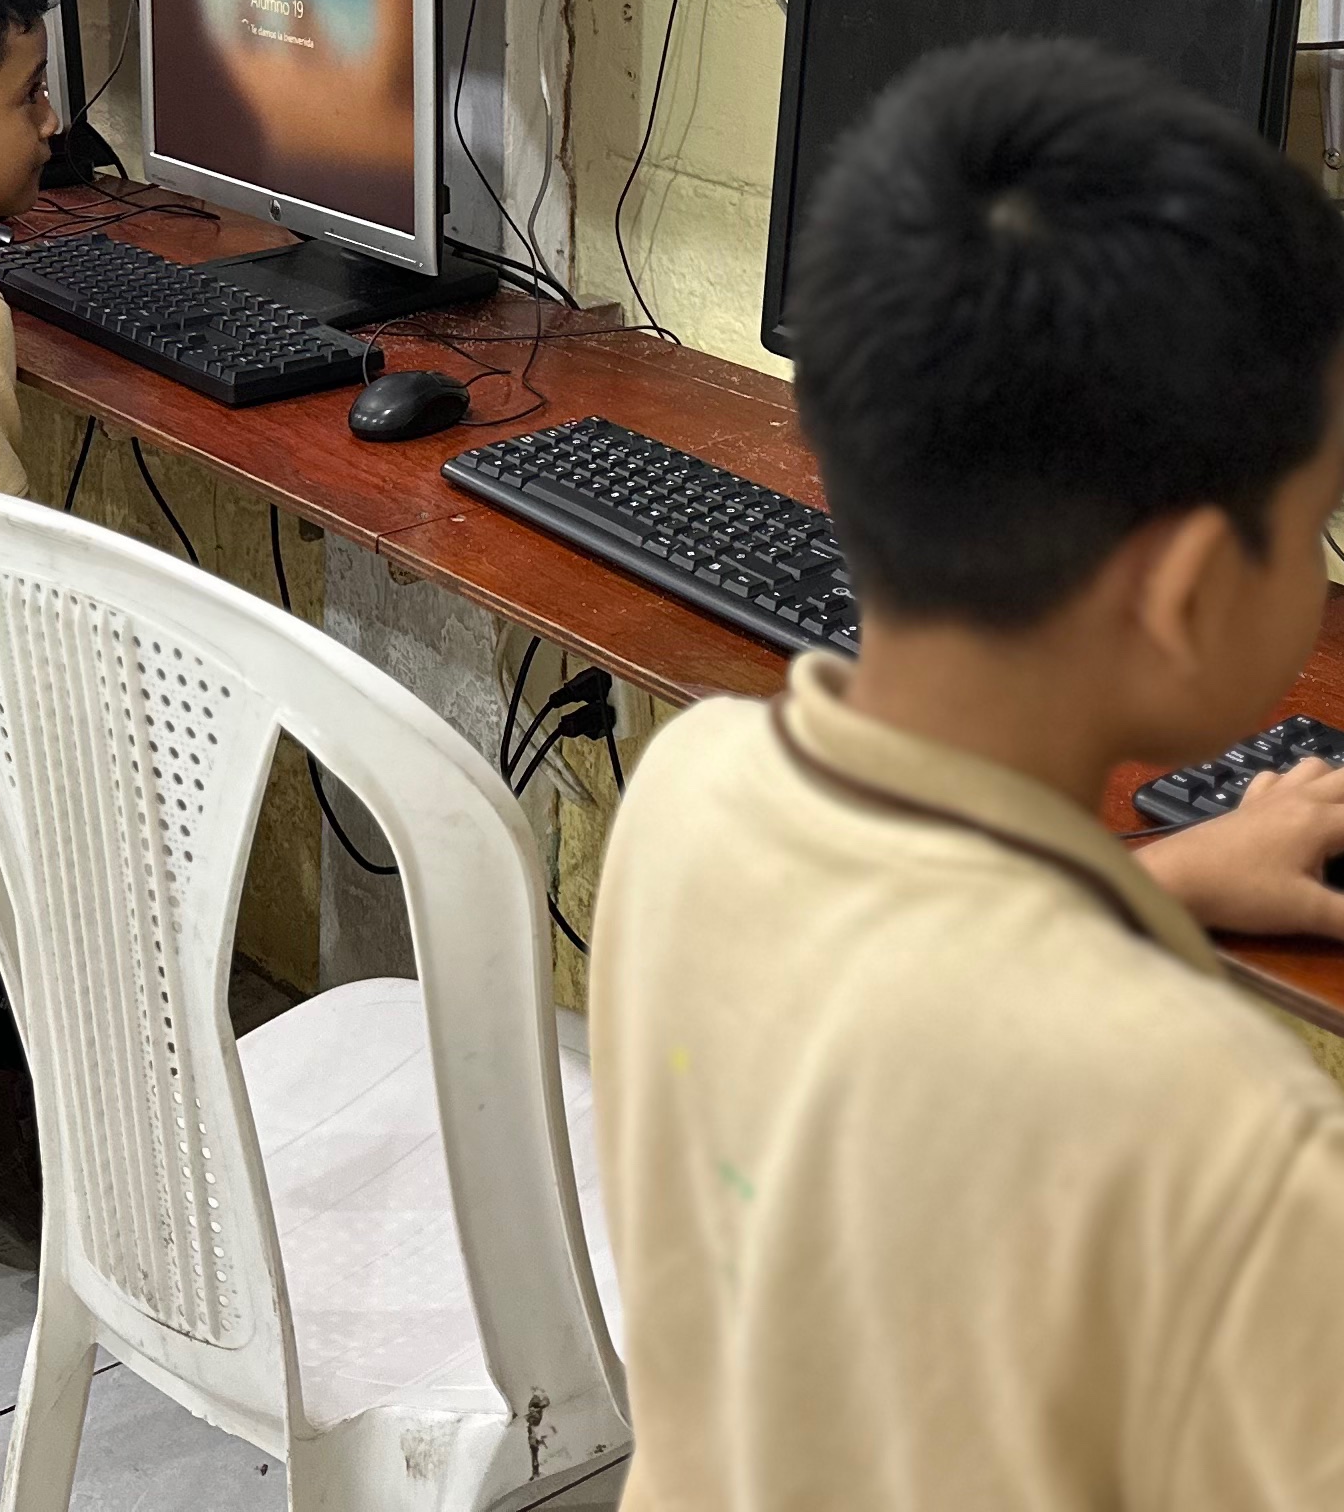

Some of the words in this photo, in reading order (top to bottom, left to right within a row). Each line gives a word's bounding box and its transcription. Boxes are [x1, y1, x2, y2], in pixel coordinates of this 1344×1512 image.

[293, 0, 304, 18] 19
[251, 24, 258, 34] Te
[284, 33, 314, 48] bienvenida
